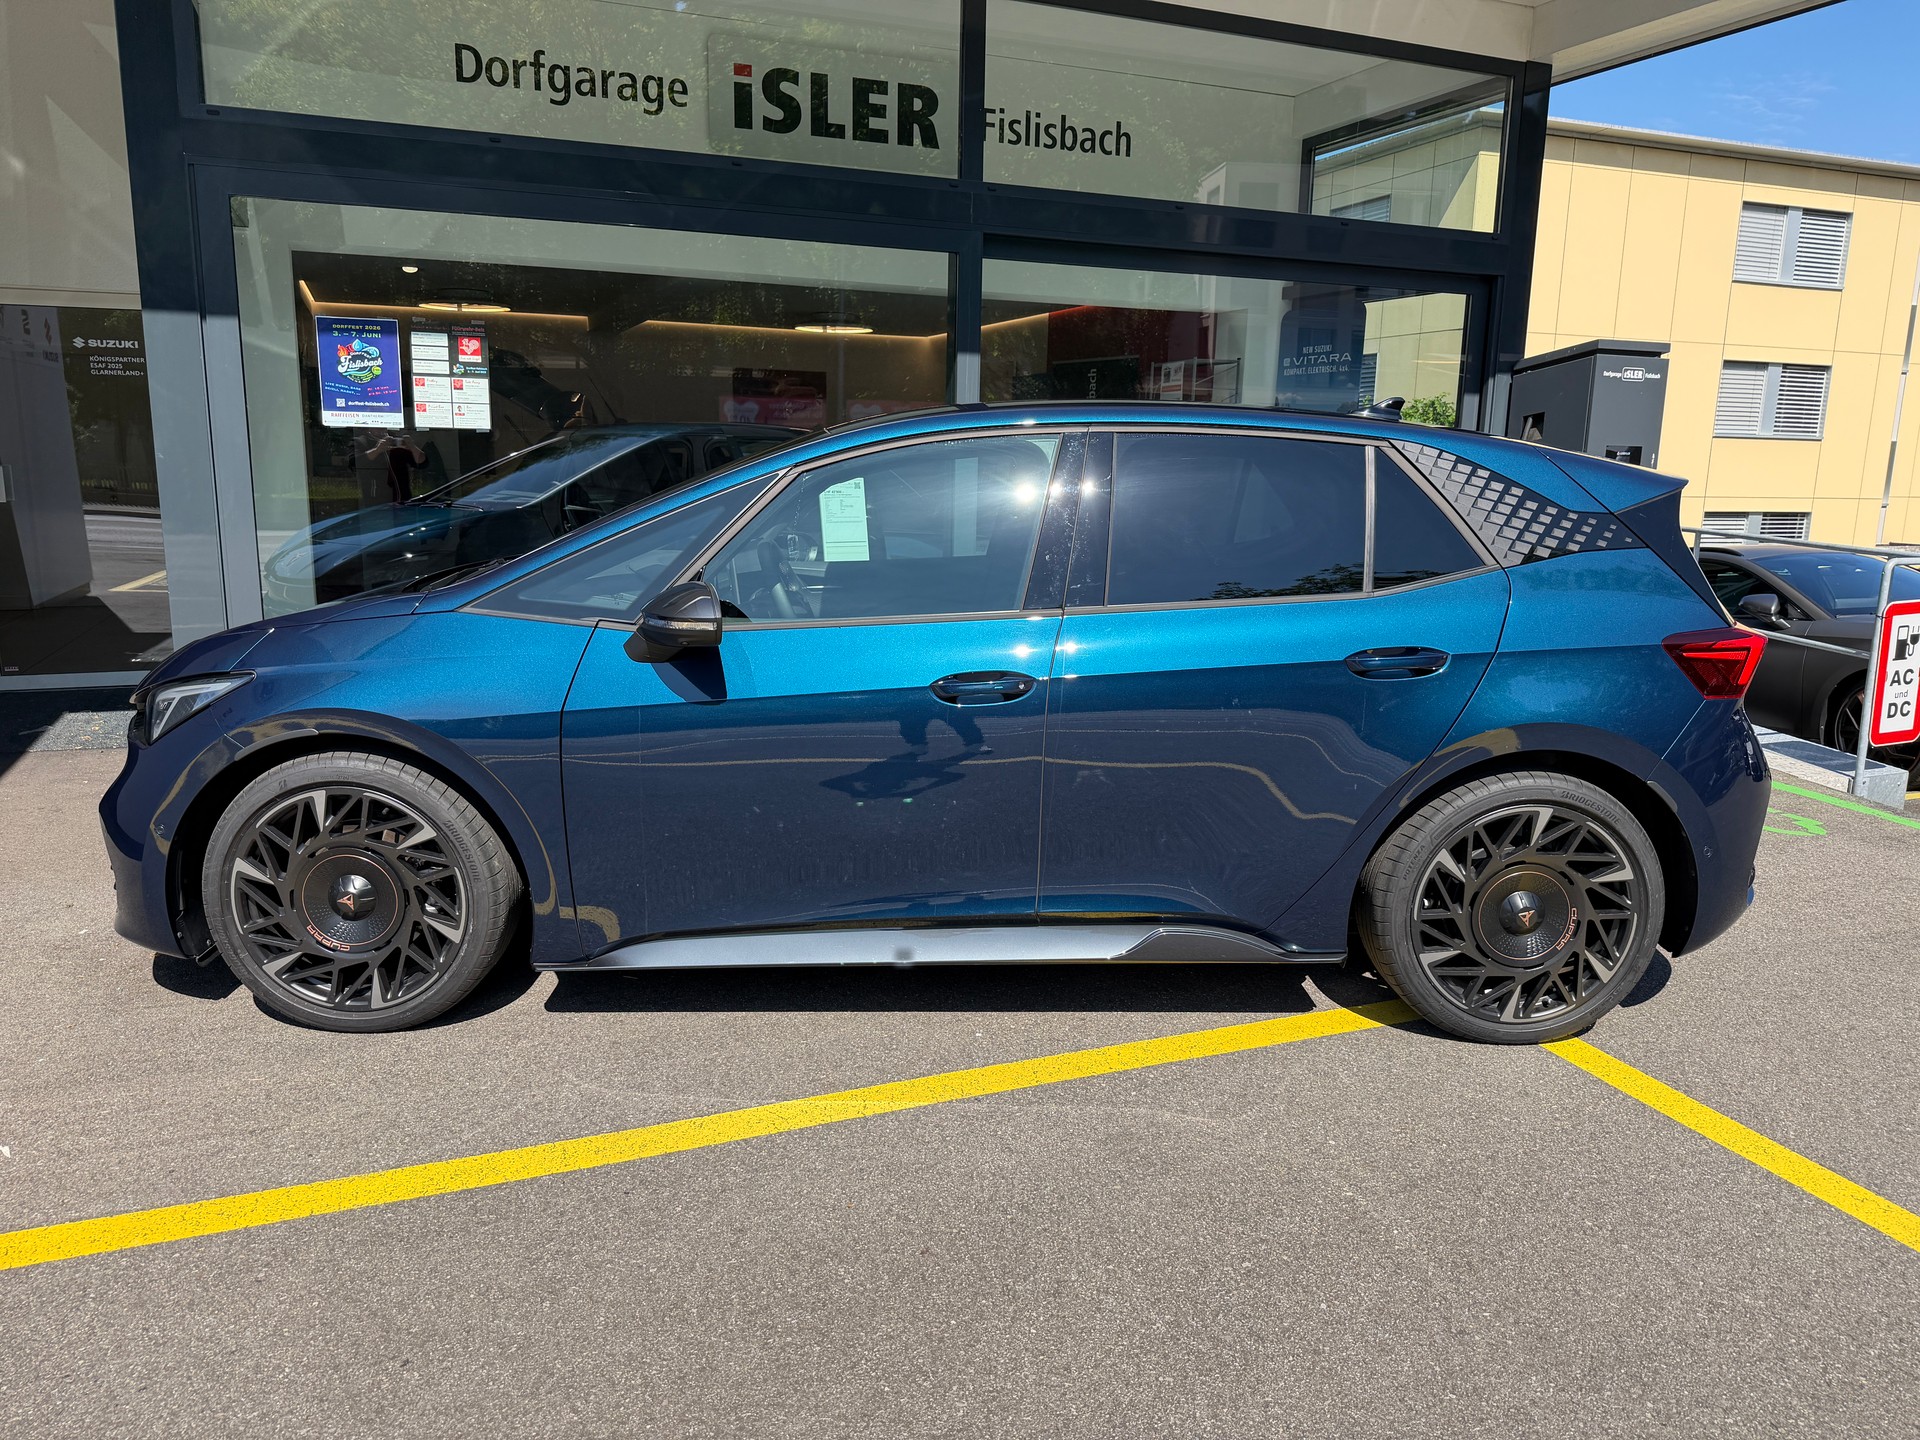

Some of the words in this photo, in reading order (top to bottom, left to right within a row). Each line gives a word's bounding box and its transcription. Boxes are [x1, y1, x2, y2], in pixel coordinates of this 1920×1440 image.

[455, 43, 689, 115] Dorfgarage
[983, 107, 1132, 157] Fislisbach
[88, 339, 139, 349] SUZUKI
[1303, 346, 1313, 354] NEW
[1314, 345, 1333, 353] SUZUKI
[90, 355, 145, 363] KÖNIGSPARTNER
[338, 356, 383, 372] Fislisbach
[1293, 353, 1351, 365] VITARA
[1284, 367, 1307, 376] KOMPAKT.
[1308, 365, 1338, 375] ELEKTRISCH.
[1890, 668, 1914, 687] AC
[1894, 690, 1908, 699] und
[1887, 702, 1911, 718] DC
[1555, 906, 1578, 952] CUPRA
[305, 924, 351, 952] CUPRA
